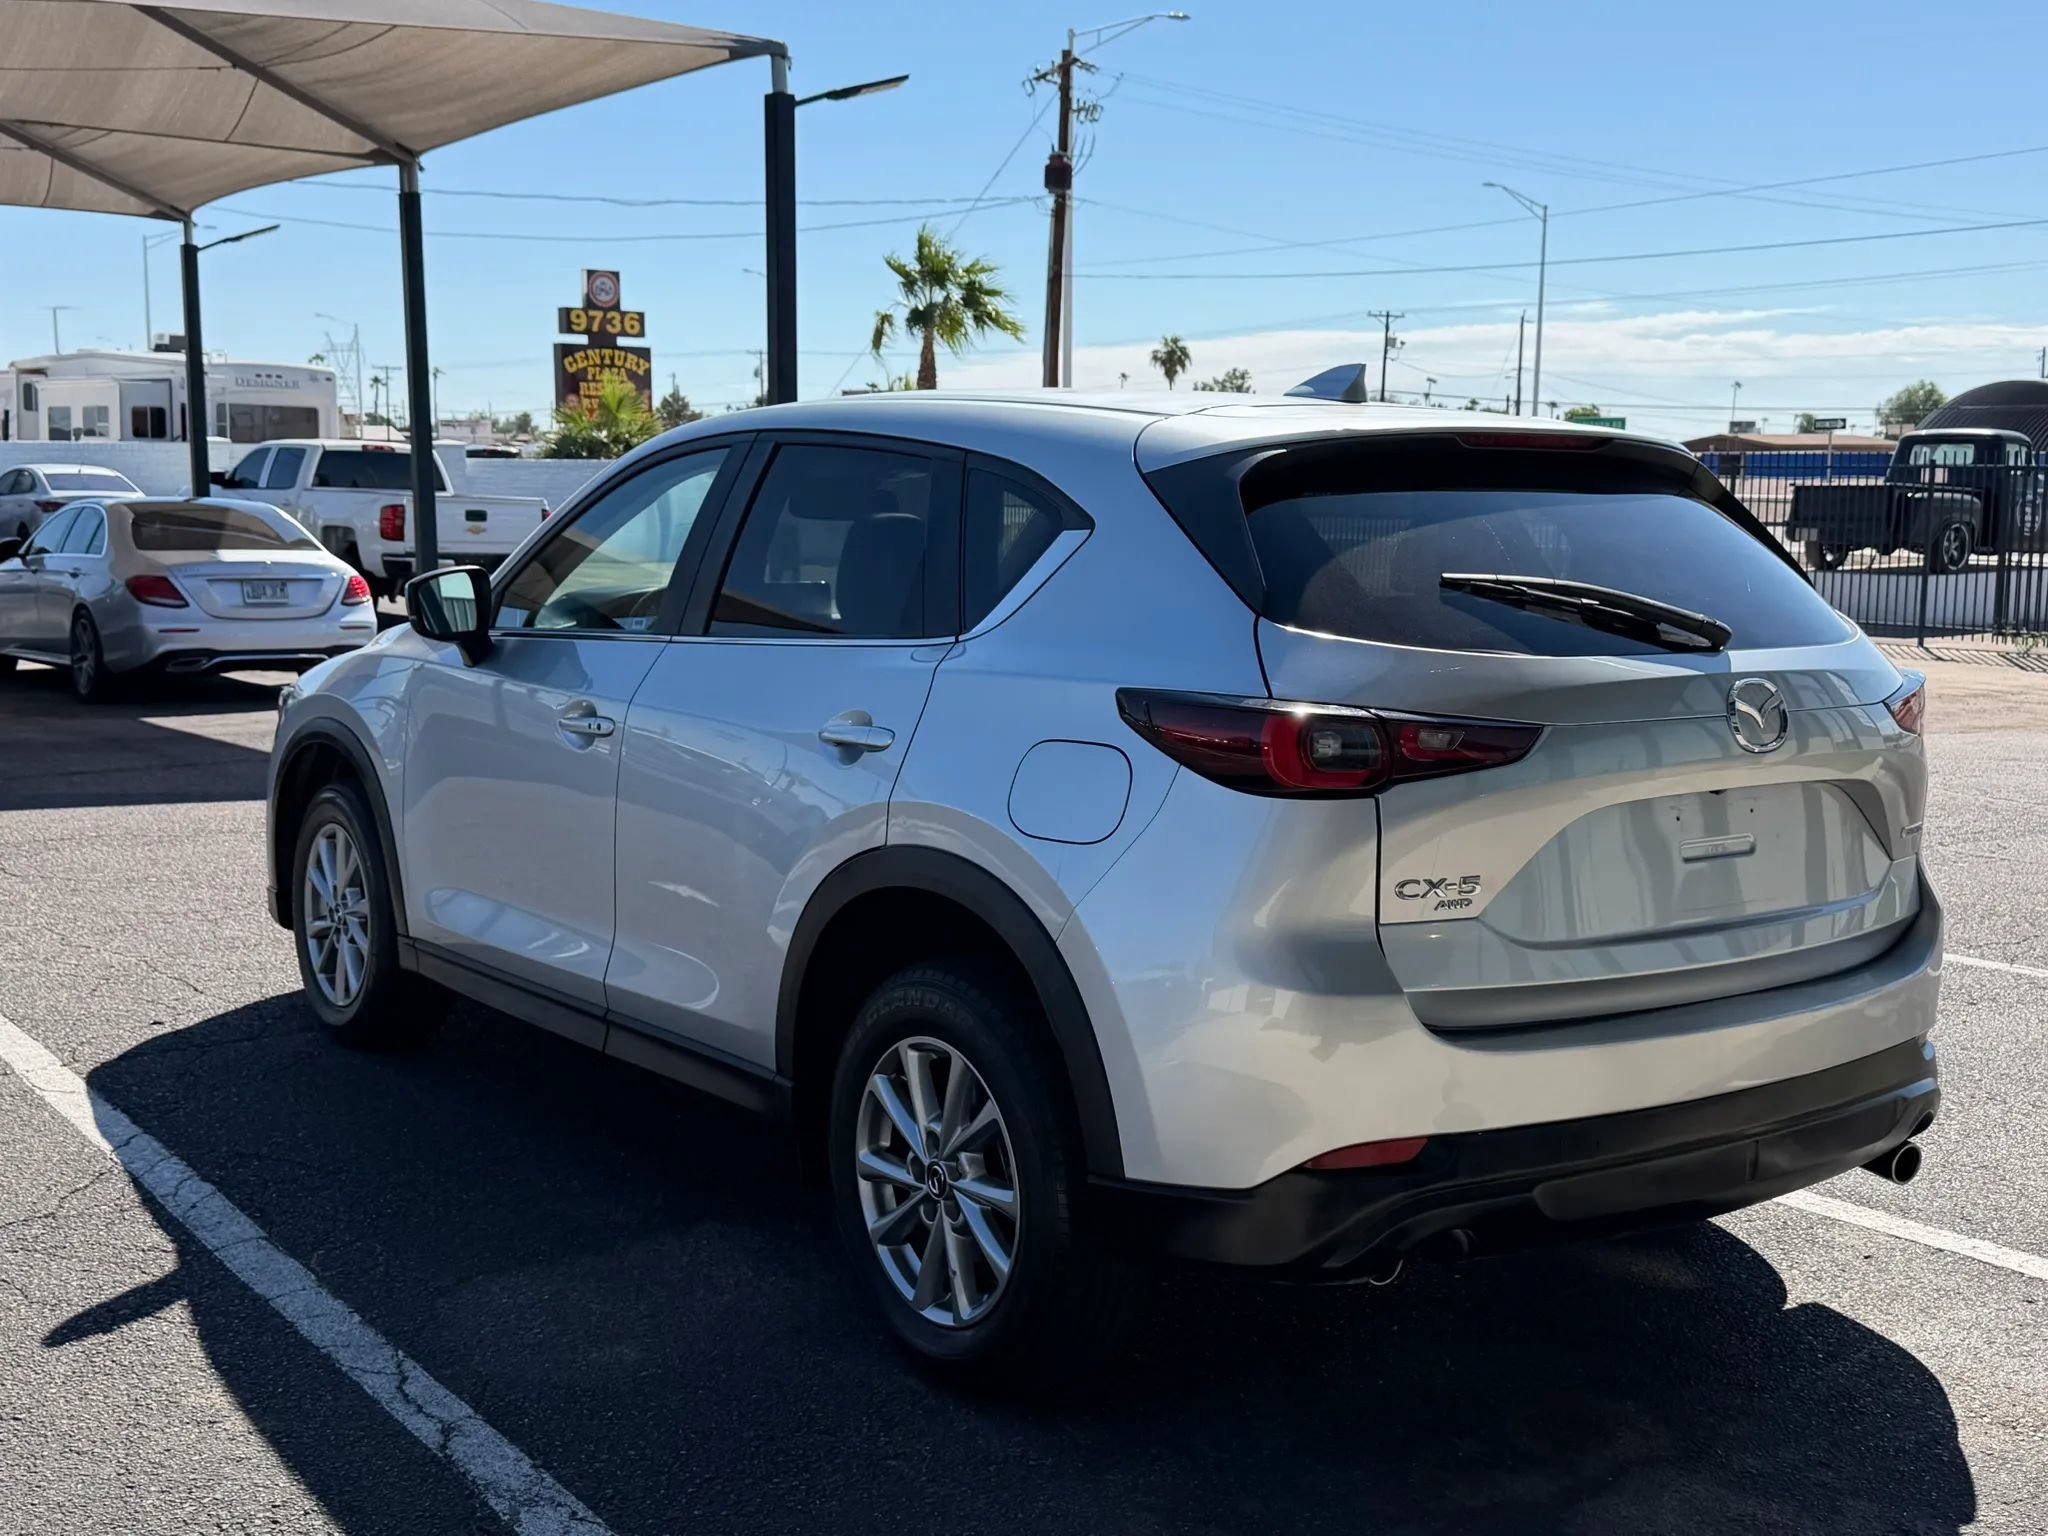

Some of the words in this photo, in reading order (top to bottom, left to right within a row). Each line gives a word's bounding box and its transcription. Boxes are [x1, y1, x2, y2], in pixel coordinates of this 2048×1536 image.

[570, 309, 640, 334] 9736
[563, 348, 650, 375] CENTURY
[235, 377, 299, 389] DESIGNER
[1394, 875, 1481, 900] CX-5
[1434, 898, 1473, 911] AWD
